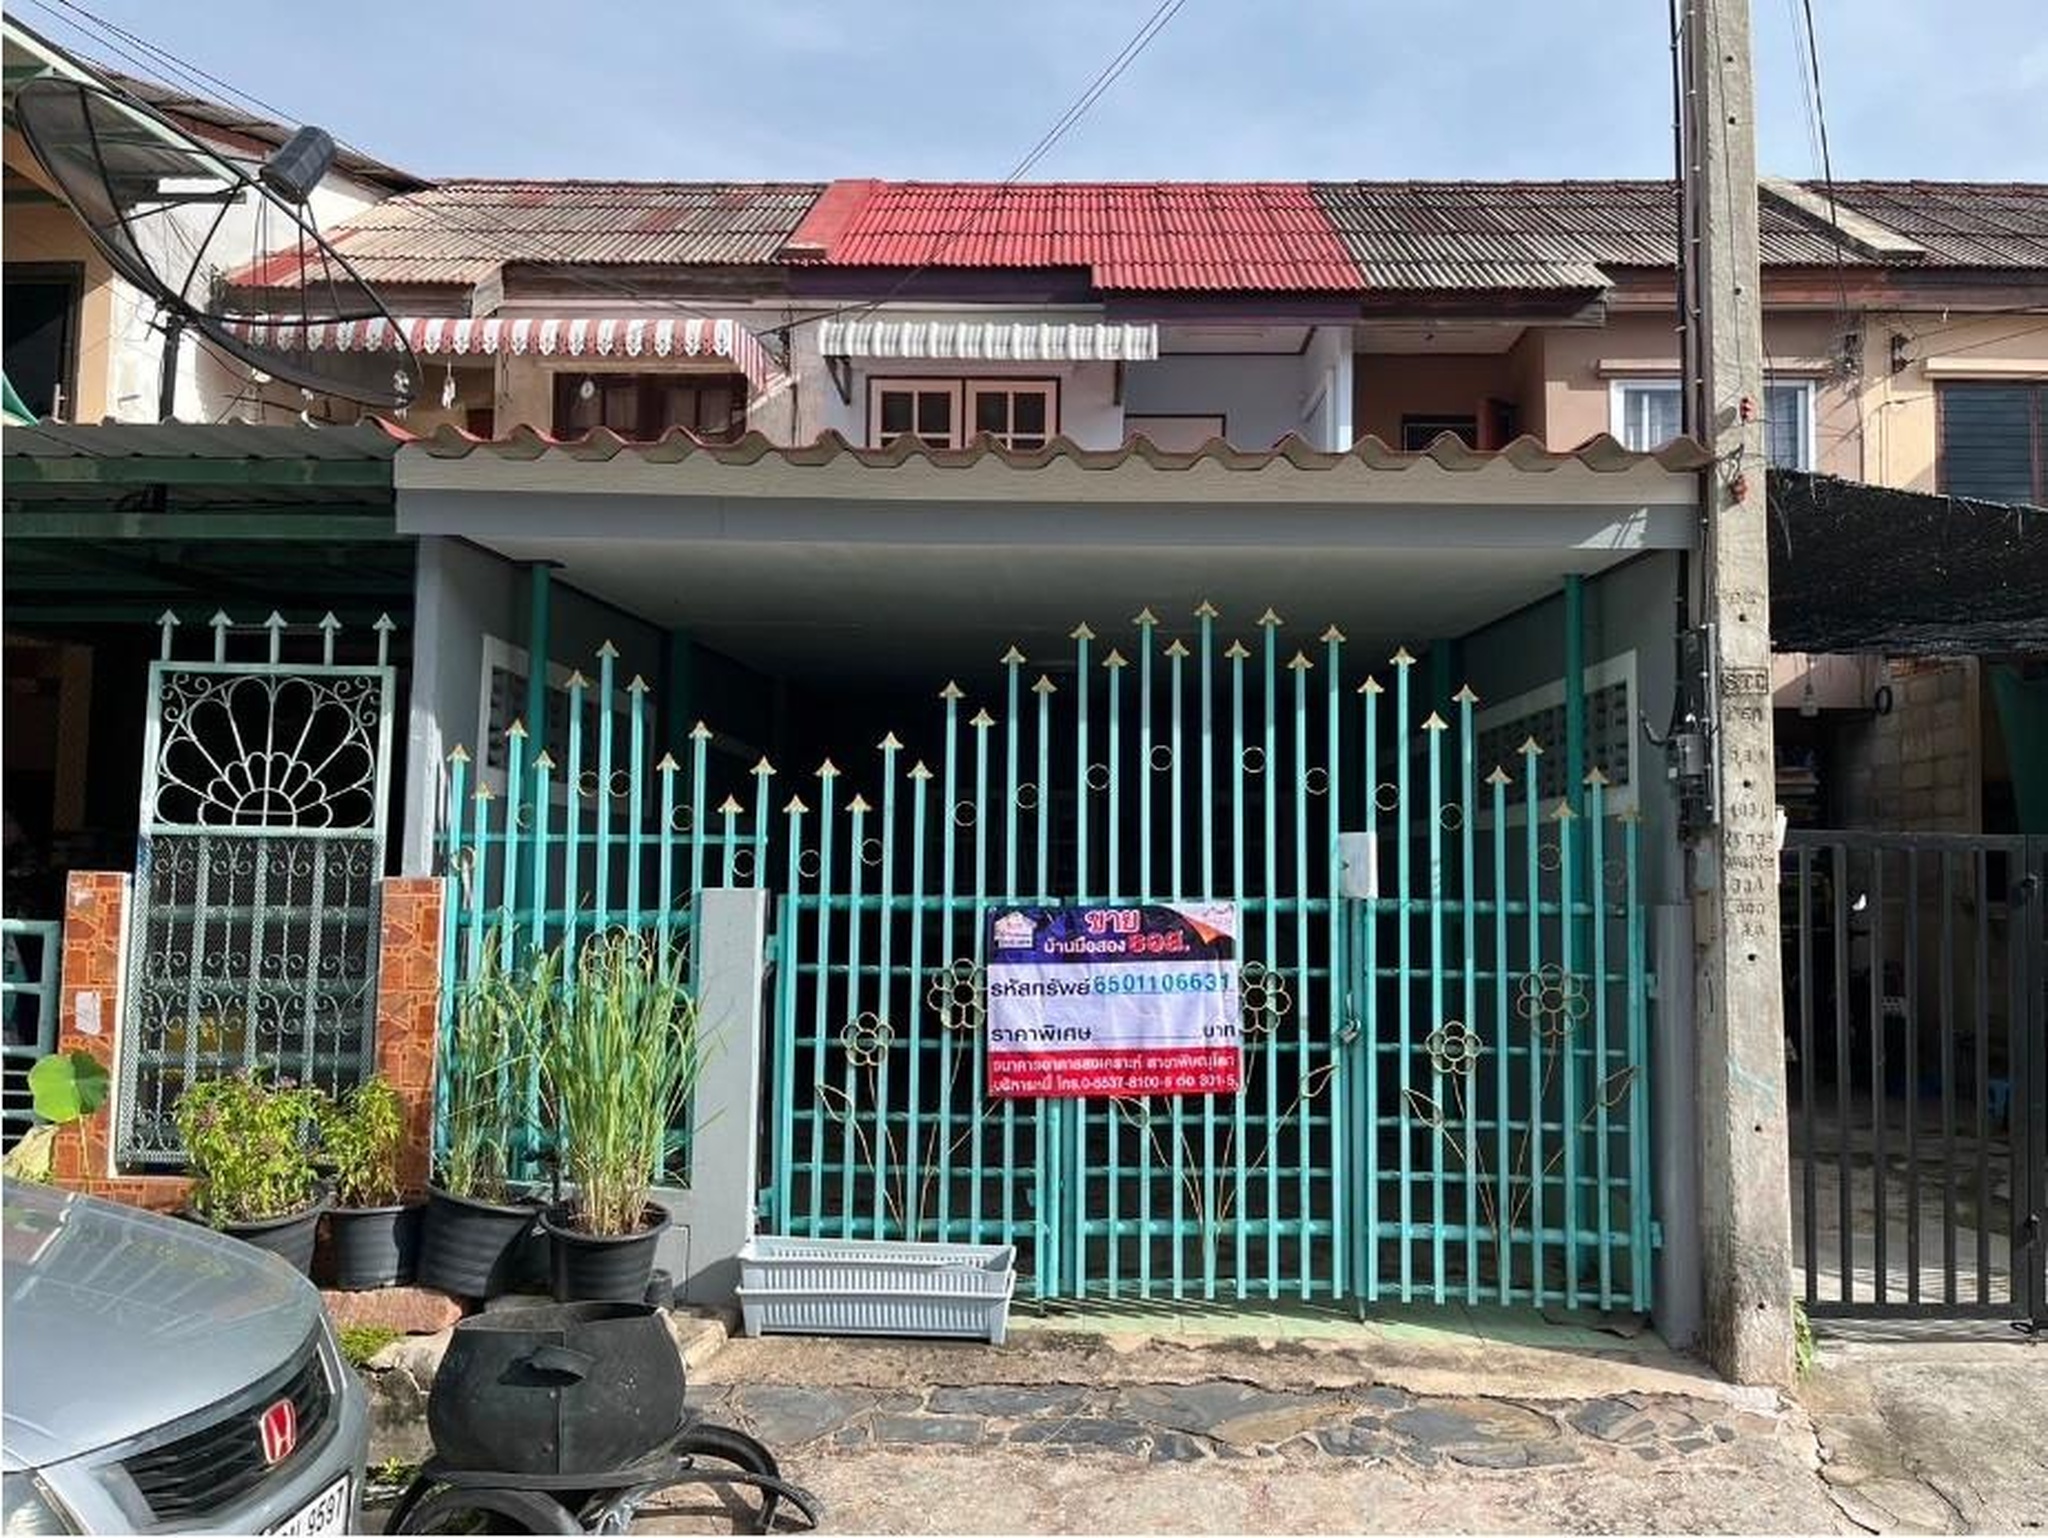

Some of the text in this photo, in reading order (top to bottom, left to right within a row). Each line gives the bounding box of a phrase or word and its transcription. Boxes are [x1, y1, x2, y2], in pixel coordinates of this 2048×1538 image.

[1084, 909, 1141, 934] ขาย
[1043, 935, 1126, 953] บ้านมือสอง
[990, 977, 1091, 997] รหัสทรัพย์
[990, 1023, 1236, 1042] ราคาพิเศษ บาท
